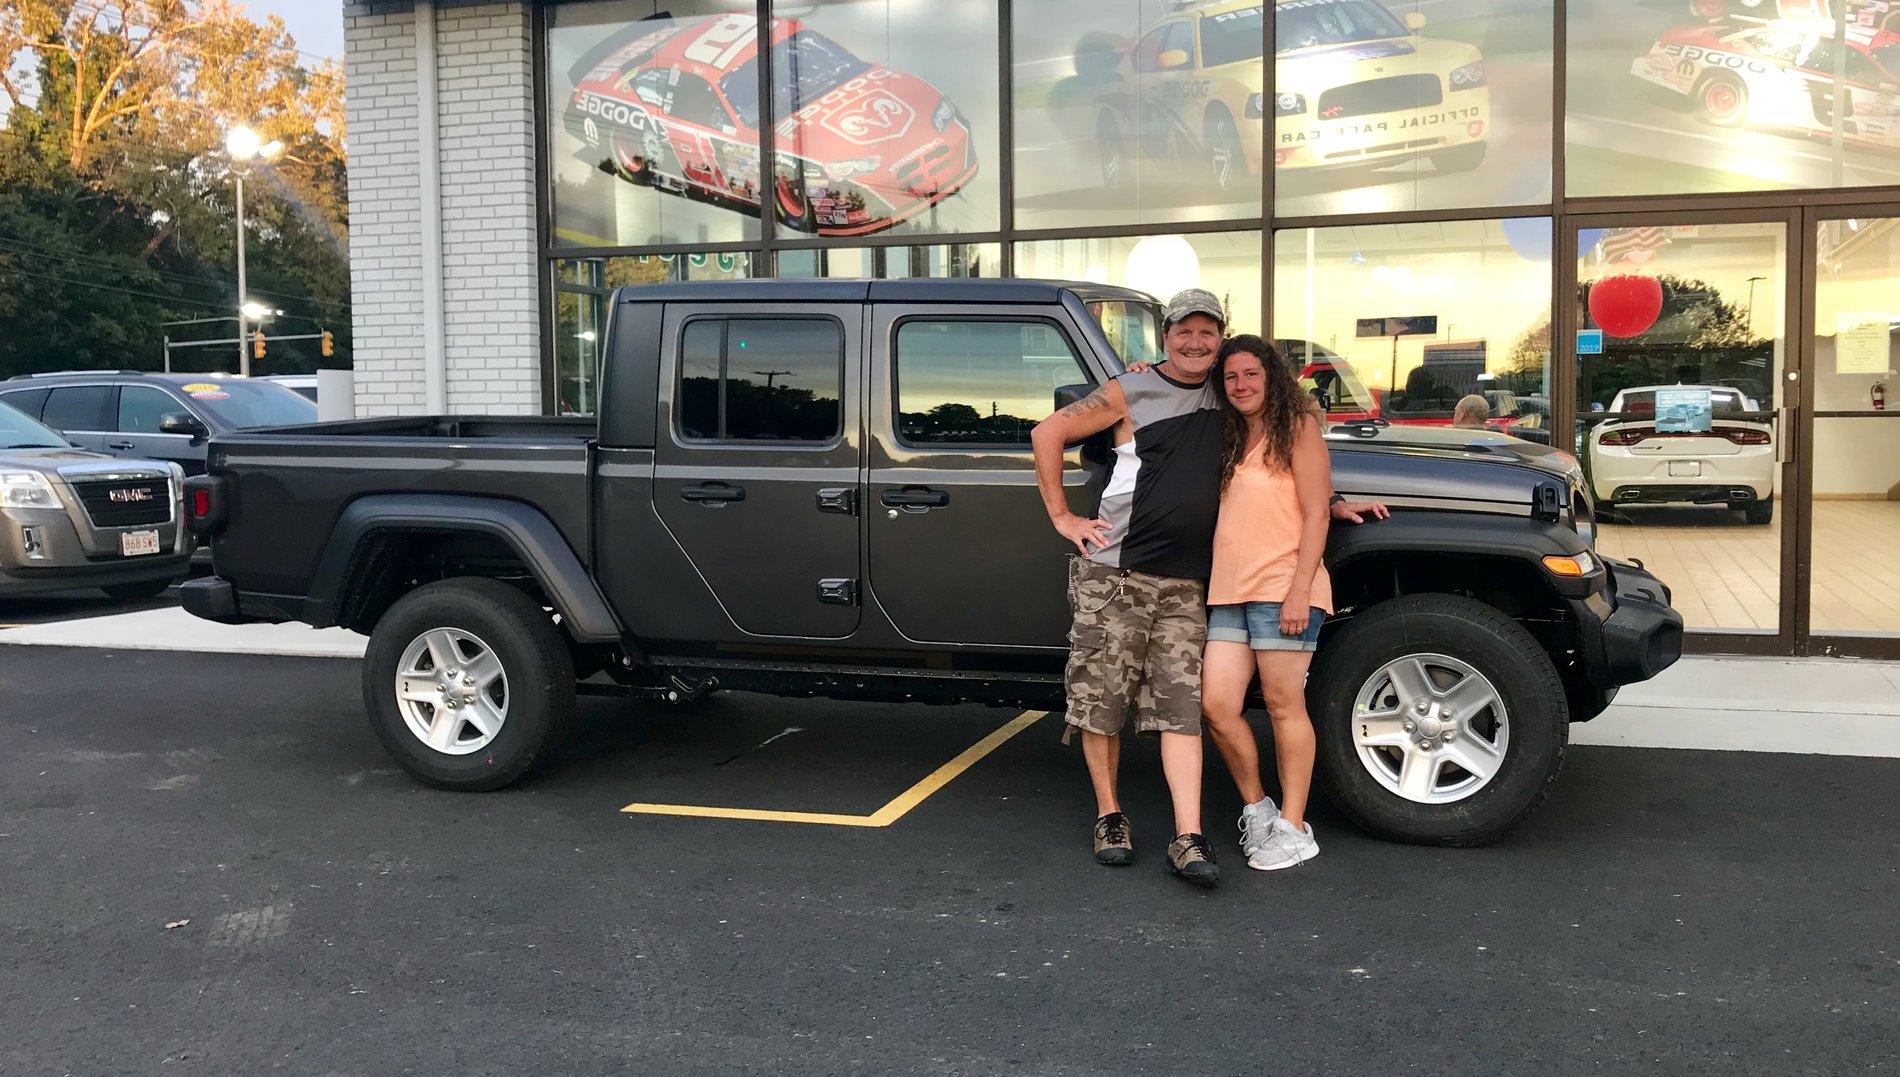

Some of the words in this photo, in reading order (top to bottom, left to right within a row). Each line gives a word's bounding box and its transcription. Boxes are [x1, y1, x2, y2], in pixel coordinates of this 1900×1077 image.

[1579, 344, 1599, 352] 2019
[109, 488, 153, 502] GMC
[125, 538, 141, 550] 868
